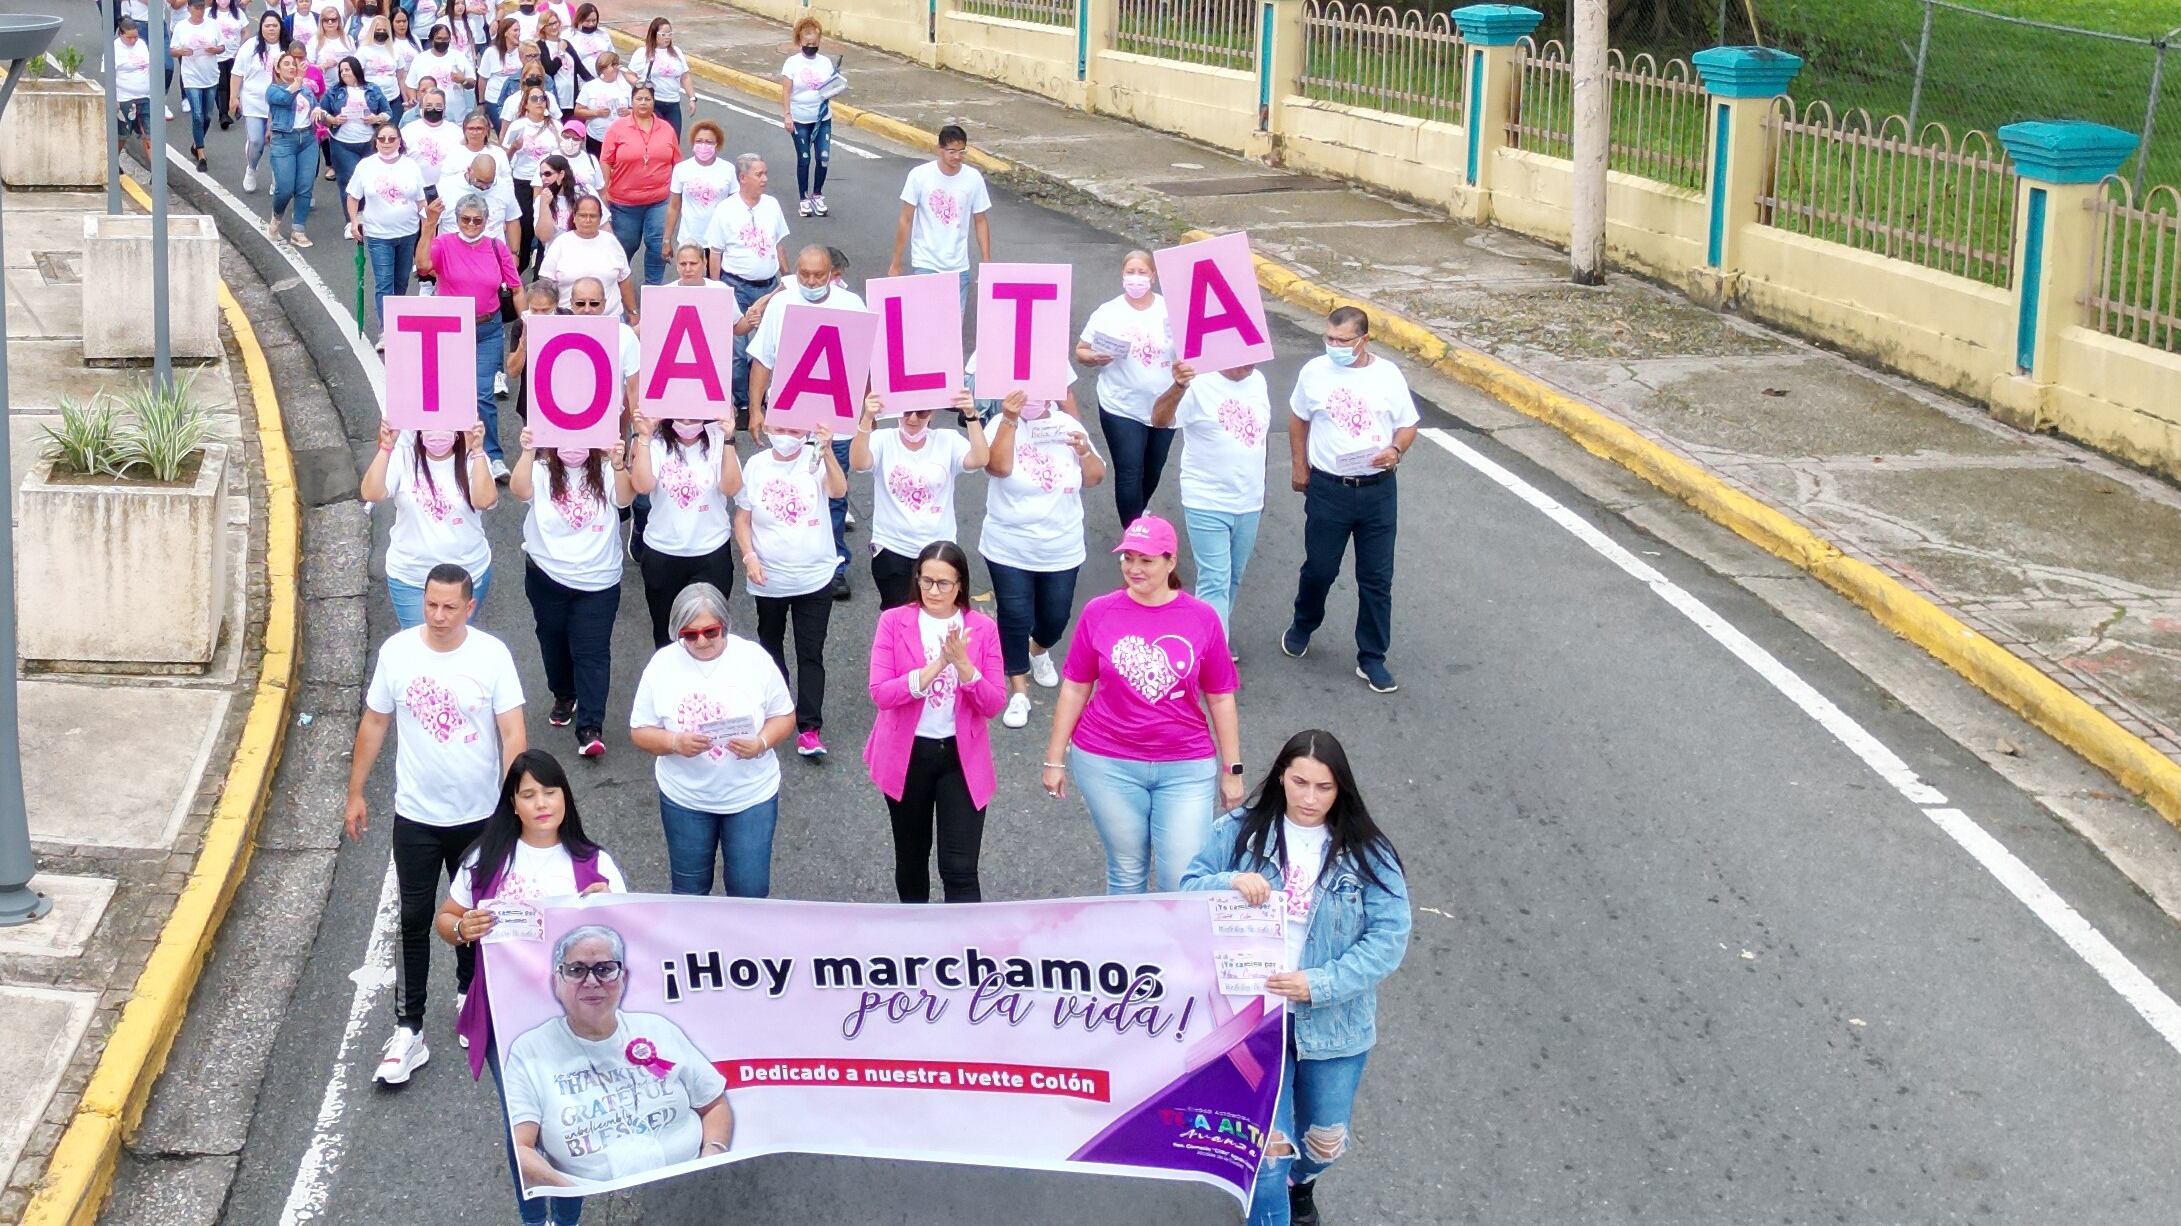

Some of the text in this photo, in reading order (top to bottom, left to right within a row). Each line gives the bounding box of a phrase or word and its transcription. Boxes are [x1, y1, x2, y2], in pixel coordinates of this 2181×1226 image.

[663, 948, 1165, 1000] ¡Hoy marchamos
[843, 972, 1196, 1041] por la vida!
[739, 1064, 1095, 1094] Dedicado a nuestra Ivette Colón
